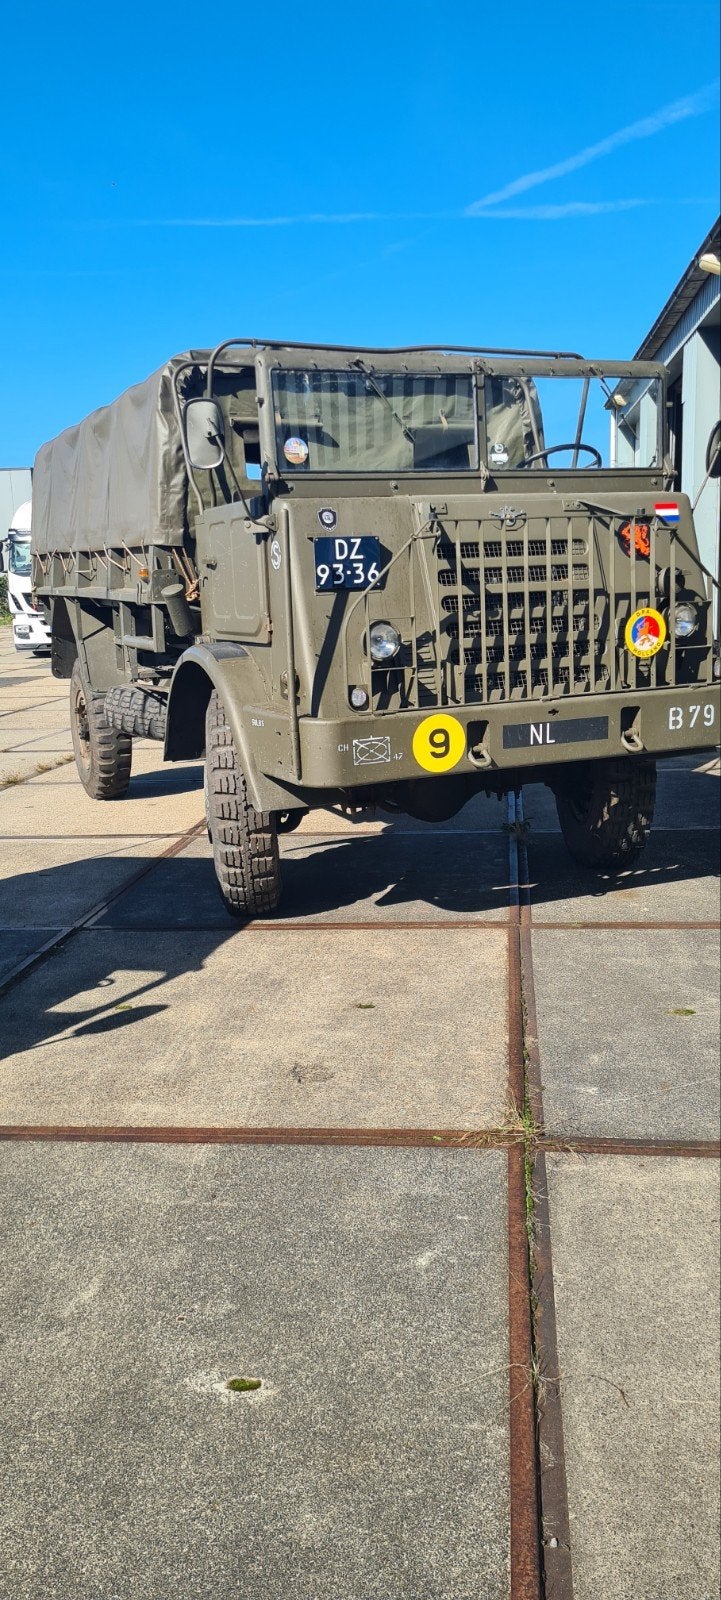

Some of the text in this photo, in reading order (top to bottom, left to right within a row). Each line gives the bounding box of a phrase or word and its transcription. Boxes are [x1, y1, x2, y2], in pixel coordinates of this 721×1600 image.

[334, 538, 364, 560] DZ
[317, 562, 379, 585] 93-36
[429, 728, 450, 759] 9
[530, 722, 555, 745] NL
[337, 744, 349, 752] CH
